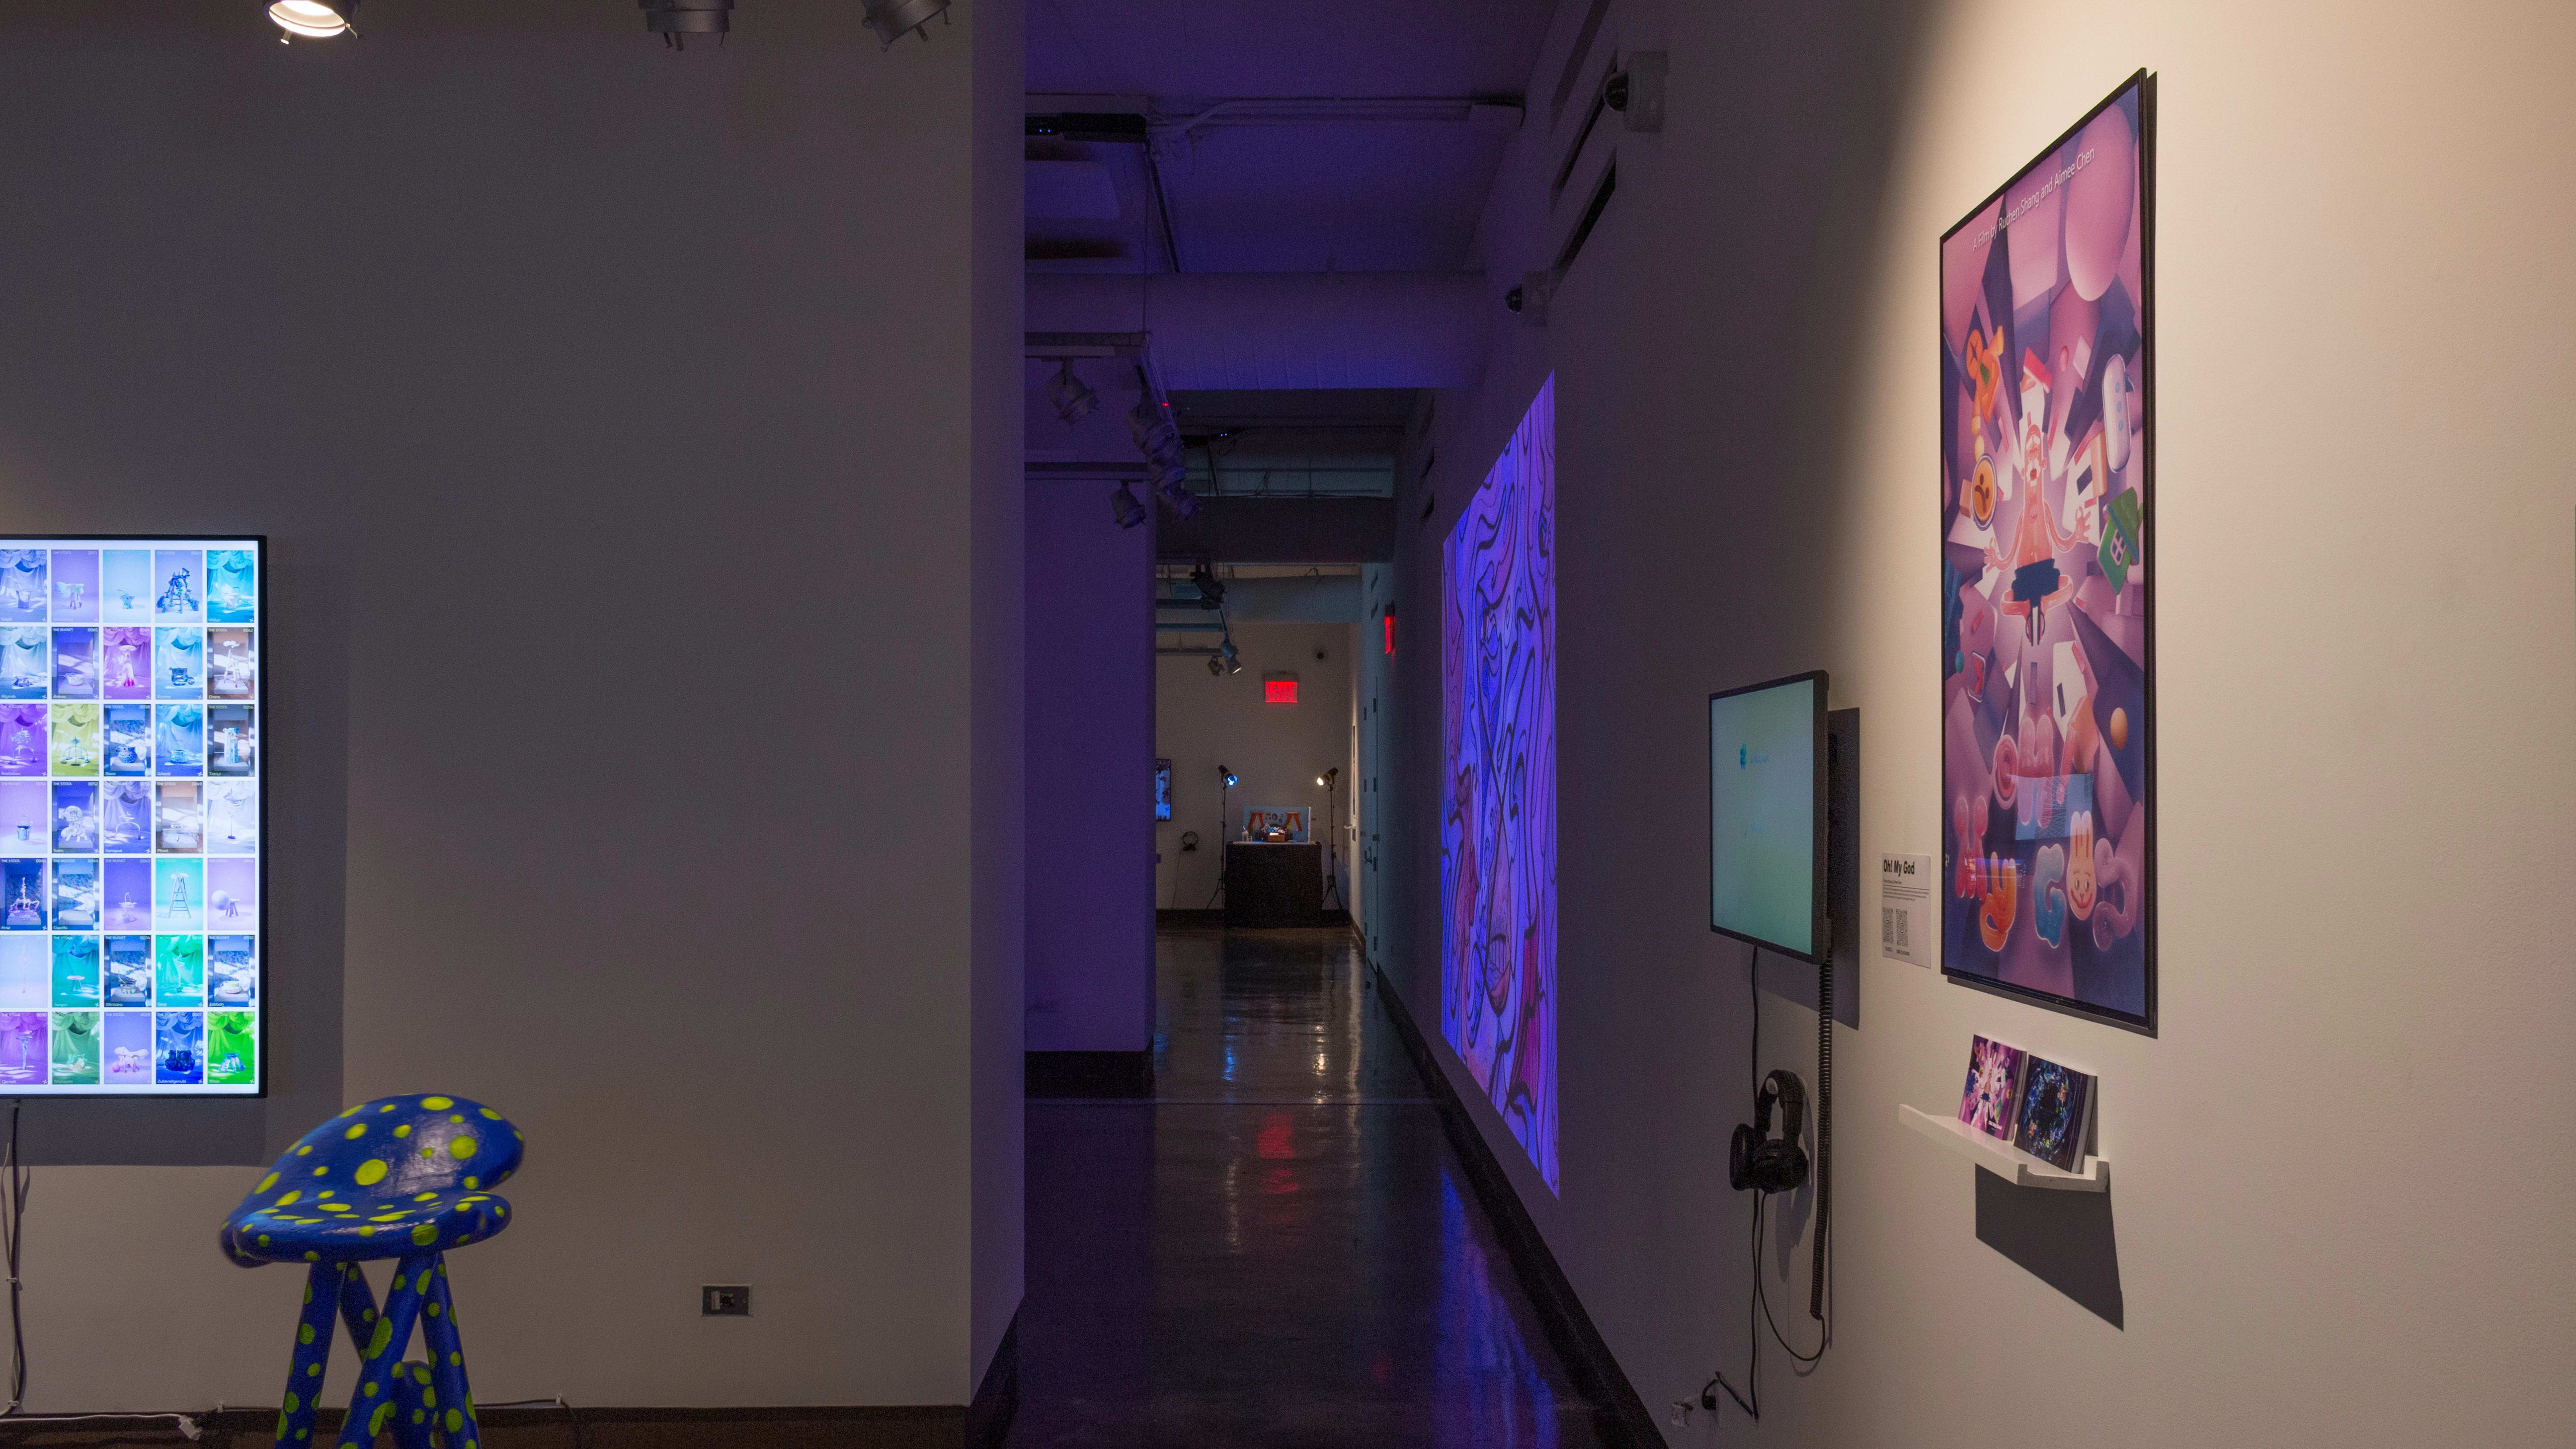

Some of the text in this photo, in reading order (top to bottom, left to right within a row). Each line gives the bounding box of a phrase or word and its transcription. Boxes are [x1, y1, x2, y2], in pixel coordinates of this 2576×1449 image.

[1973, 148, 2095, 251] A Film by Ruchen Shang and Aimee Chen
[1883, 859, 1914, 877] Oh! My God
